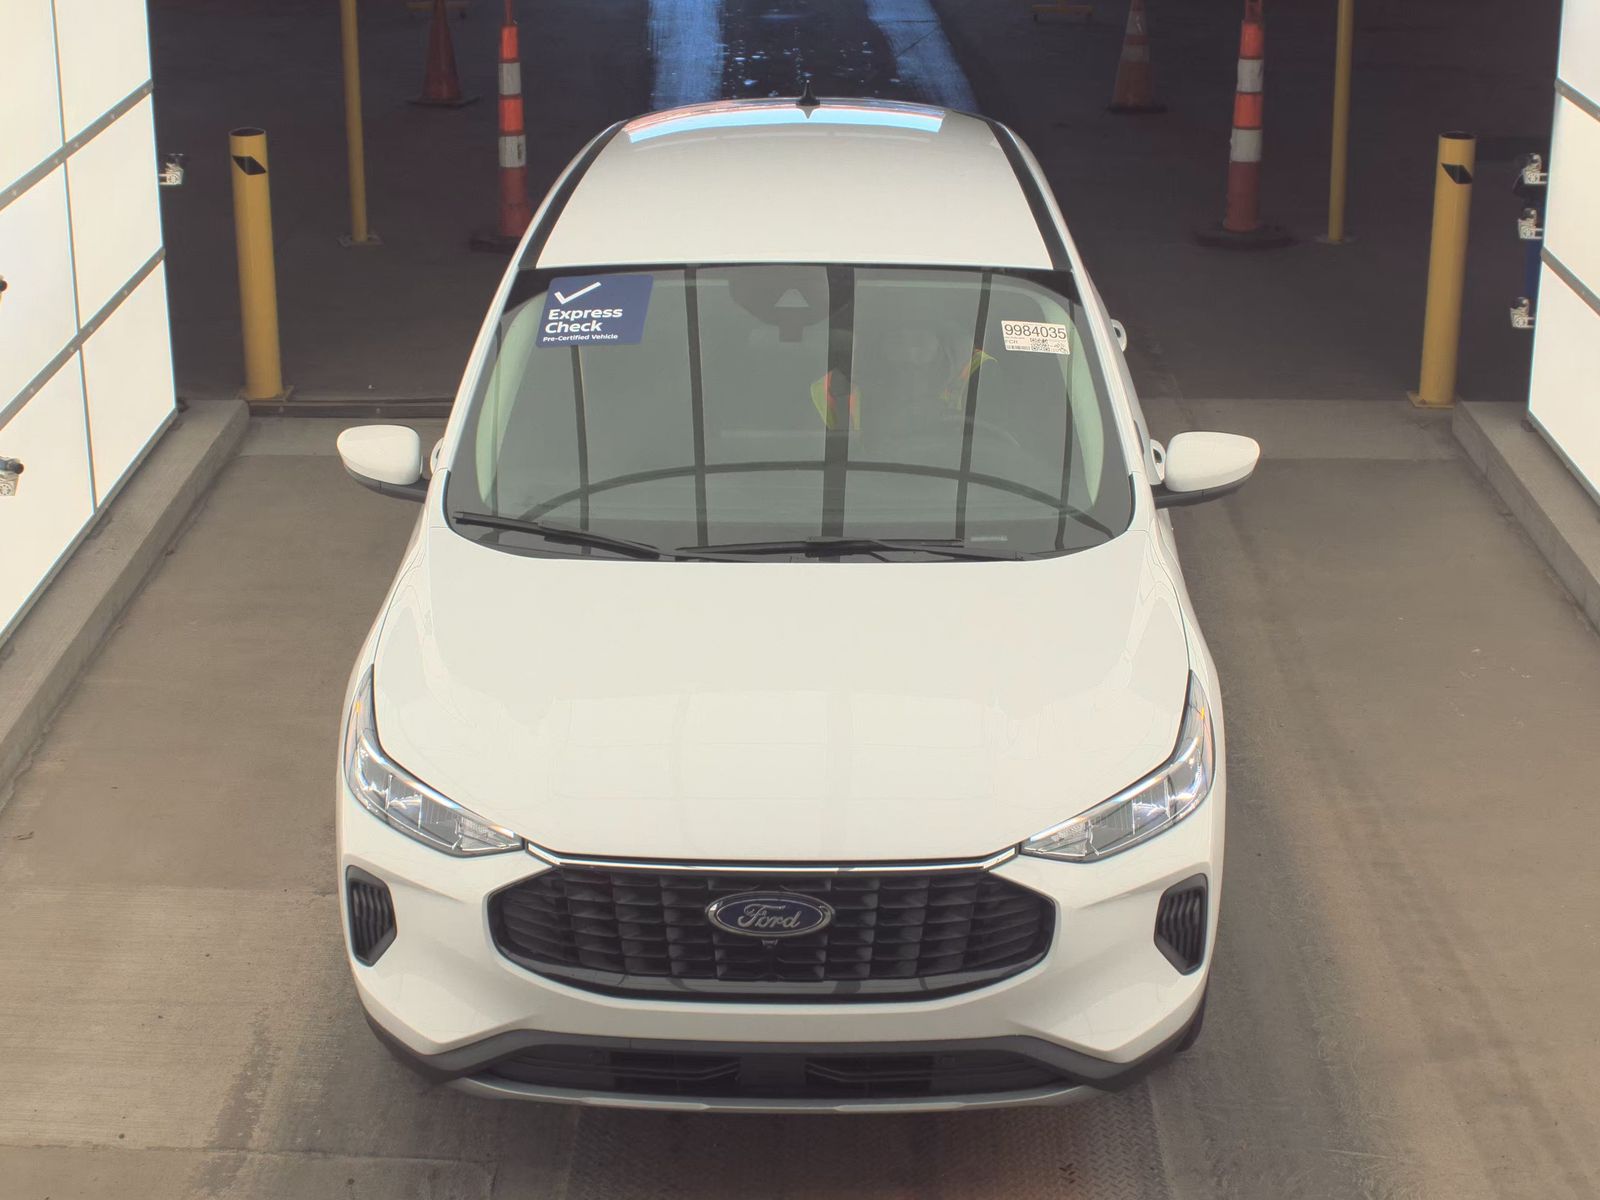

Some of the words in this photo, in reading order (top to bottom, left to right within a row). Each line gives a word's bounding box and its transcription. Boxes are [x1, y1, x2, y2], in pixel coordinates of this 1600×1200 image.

[548, 308, 623, 321] Express
[545, 320, 603, 334] Check
[1004, 324, 1067, 340] 9984035
[543, 334, 590, 342] Pre-Certified
[737, 903, 802, 928] Ford
